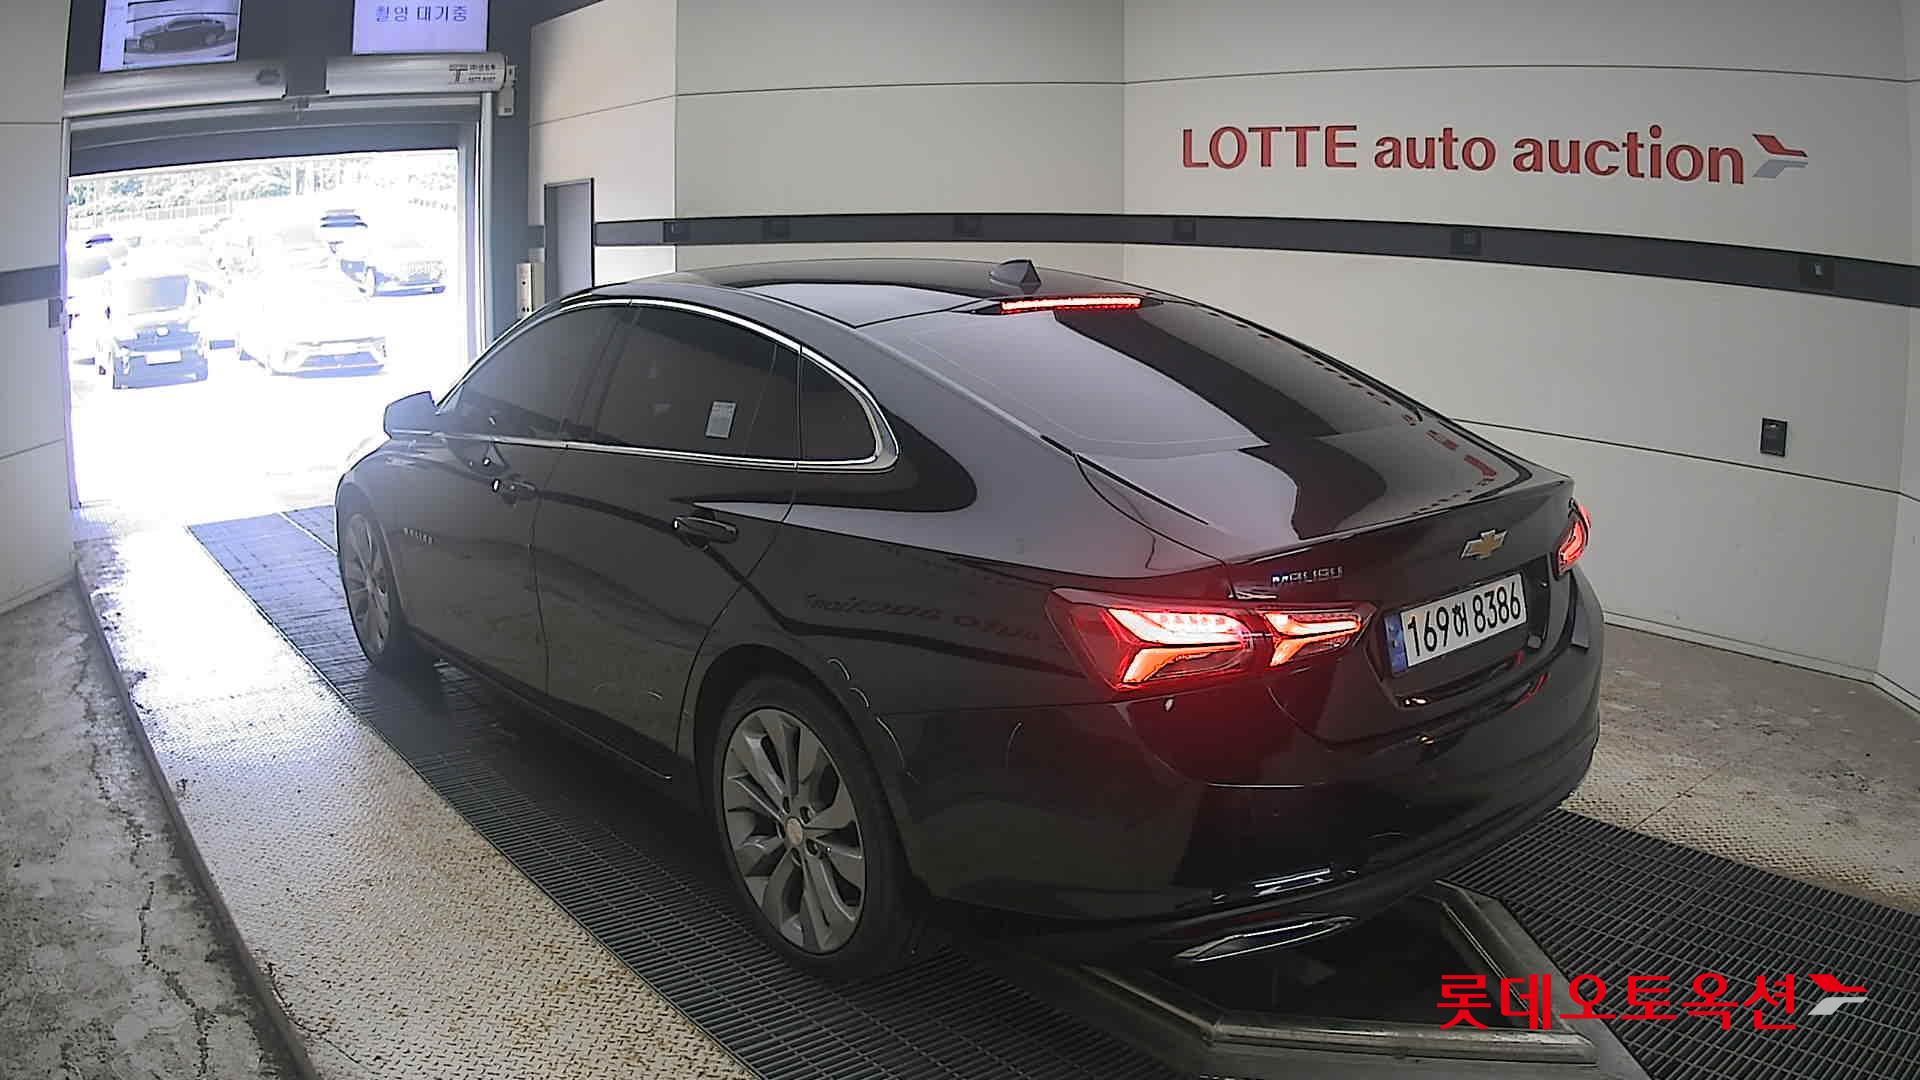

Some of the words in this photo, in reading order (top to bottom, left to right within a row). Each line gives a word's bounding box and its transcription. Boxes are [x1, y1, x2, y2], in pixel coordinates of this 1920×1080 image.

[416, 5, 468, 23] 대기중
[1182, 125, 1357, 169] LOTTE
[1374, 127, 1496, 171] auto
[1513, 125, 1744, 185] auction
